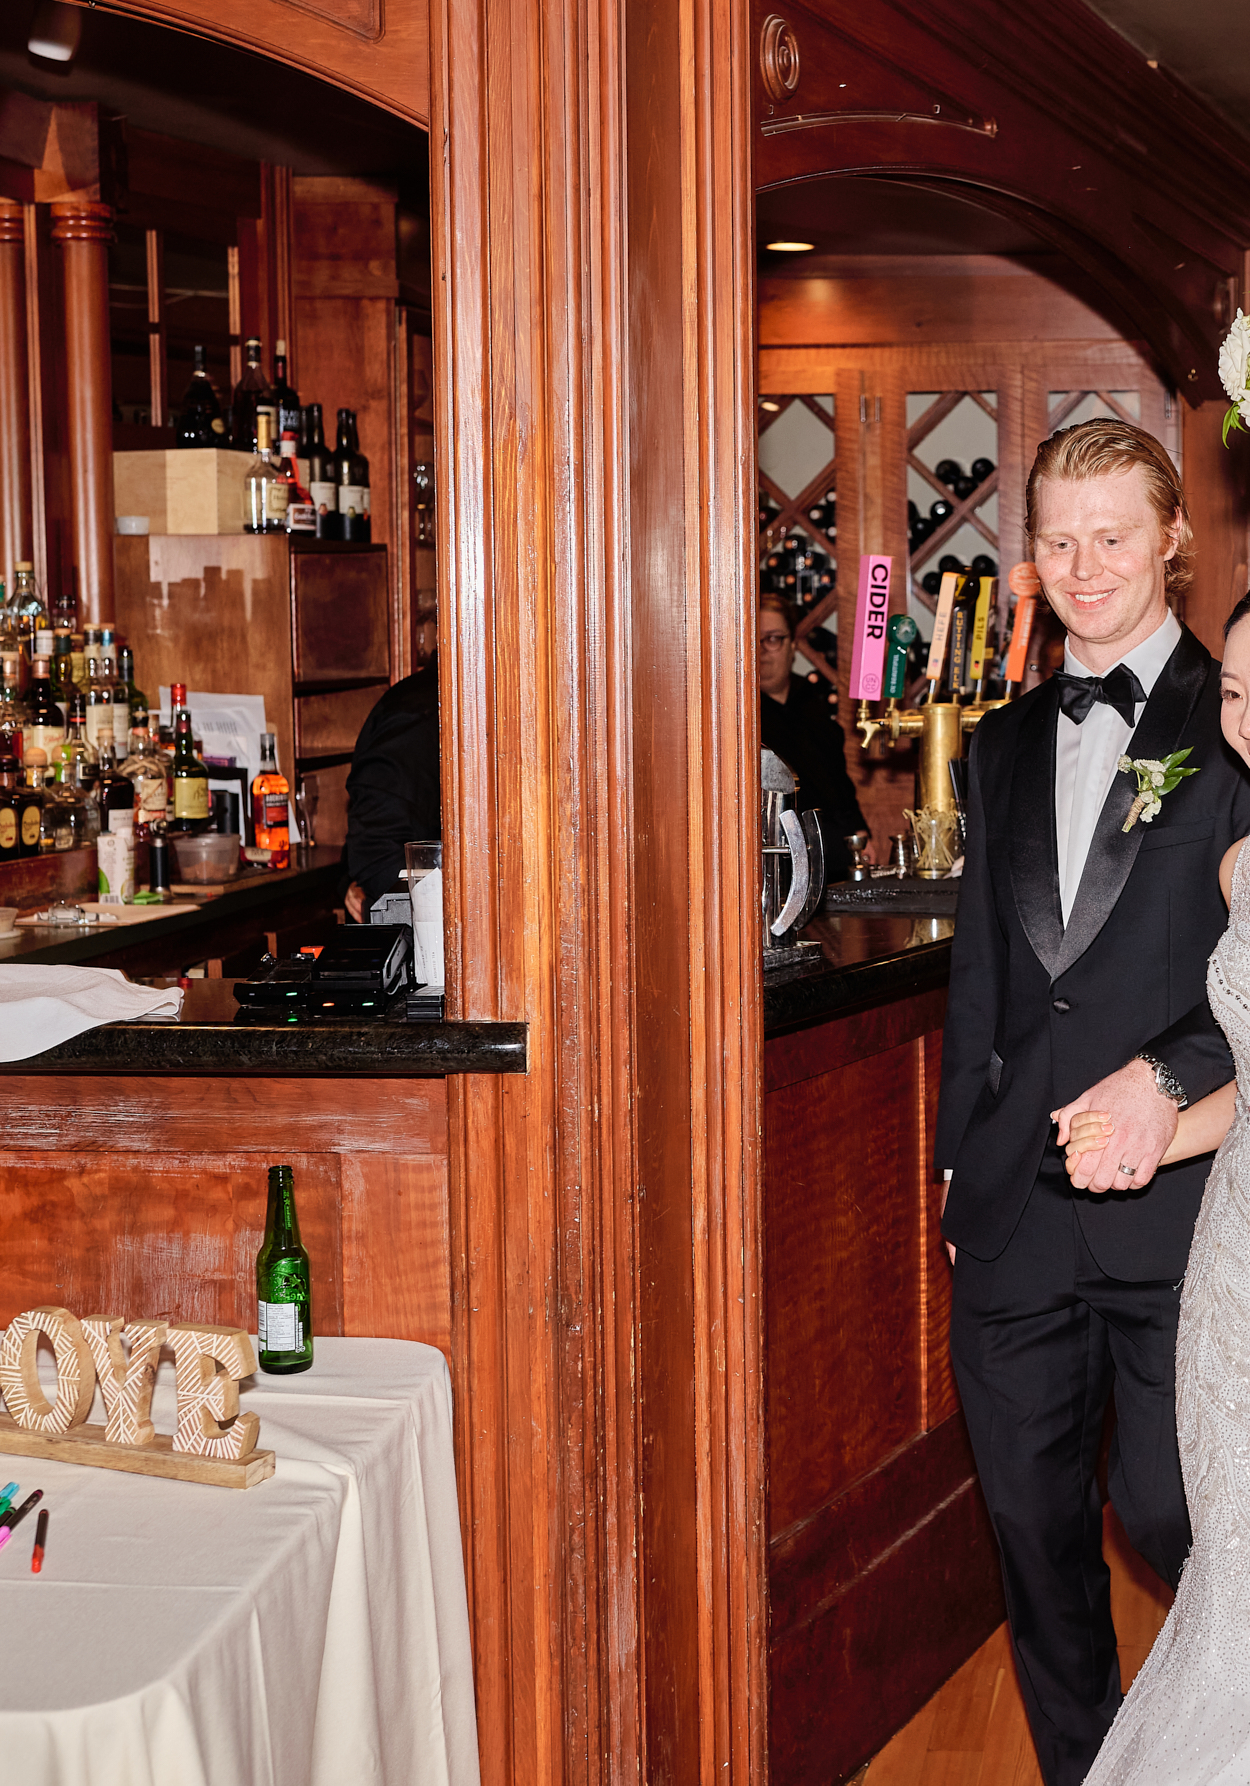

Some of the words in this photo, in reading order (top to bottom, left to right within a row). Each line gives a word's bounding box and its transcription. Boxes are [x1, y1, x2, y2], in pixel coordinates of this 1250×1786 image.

[867, 564, 888, 639] CIDER
[935, 611, 947, 641] HEFE
[975, 616, 985, 641] PILS
[952, 668, 961, 689] ELK
